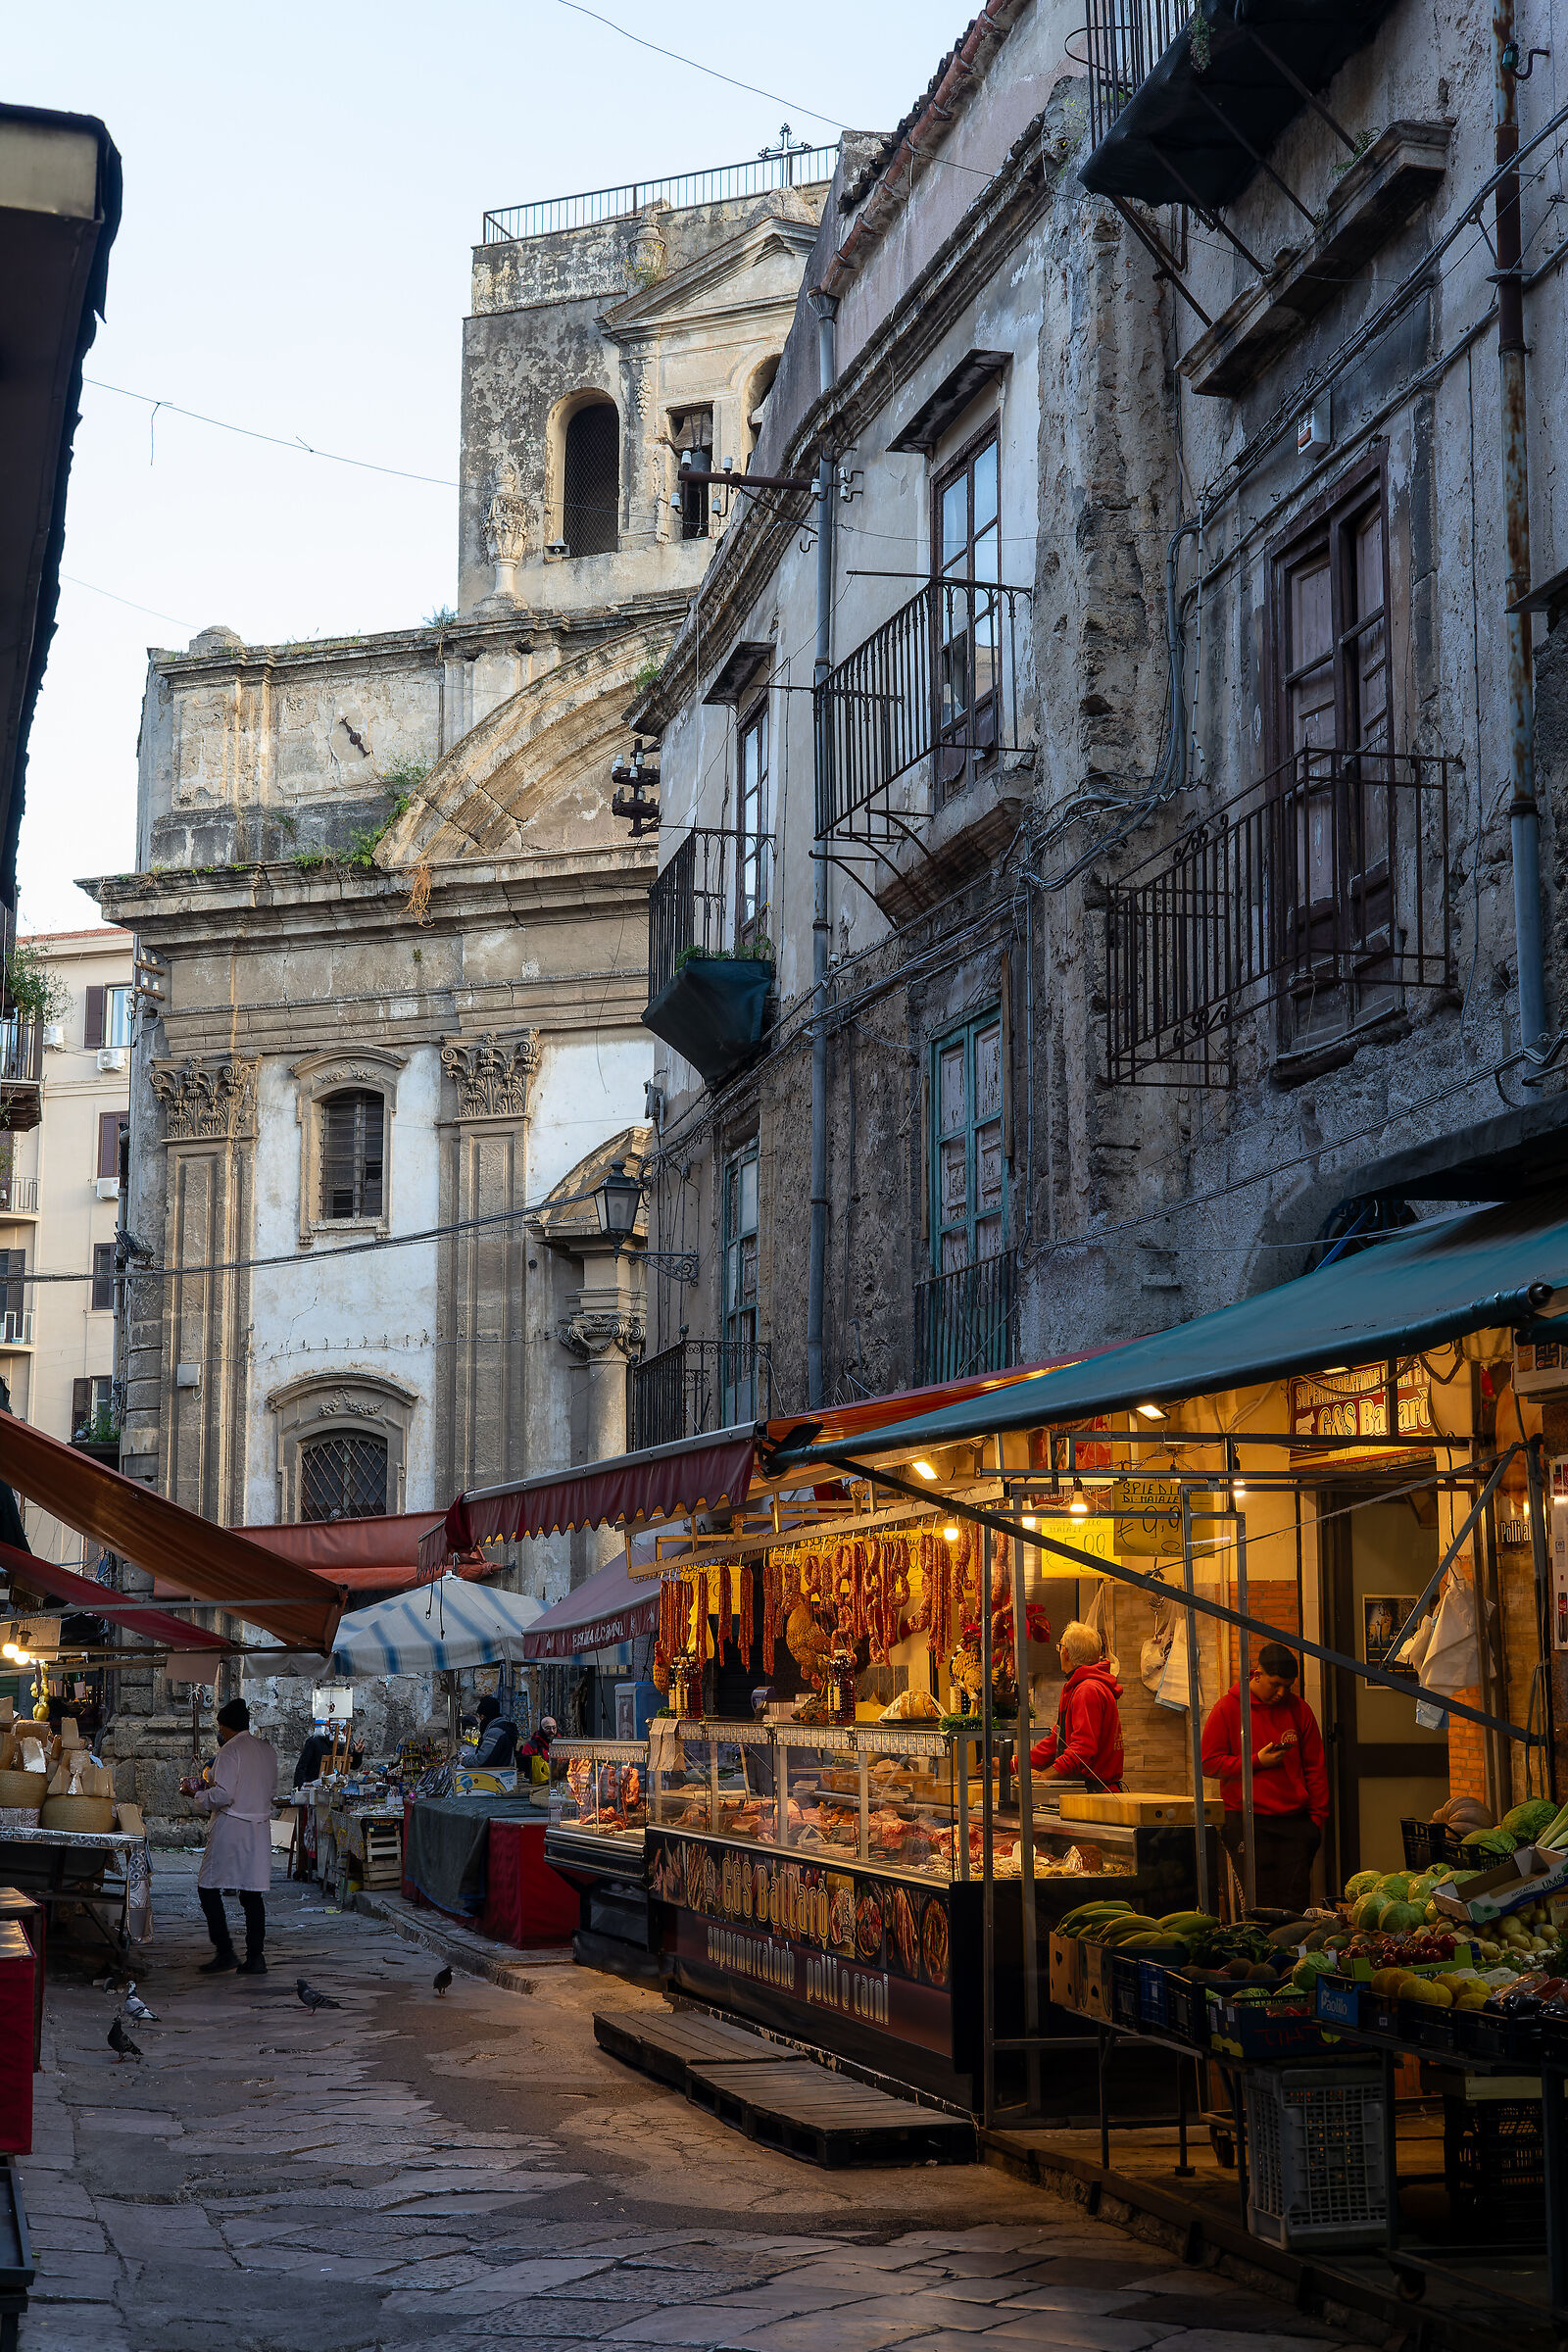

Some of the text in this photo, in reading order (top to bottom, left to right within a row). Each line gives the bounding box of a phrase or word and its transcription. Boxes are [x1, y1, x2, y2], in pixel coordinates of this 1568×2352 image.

[1318, 1401, 1357, 1436] G&S
[1500, 1520, 1522, 1543] Polli
[807, 1954, 838, 2004] polli
[855, 1973, 889, 2025] carni
